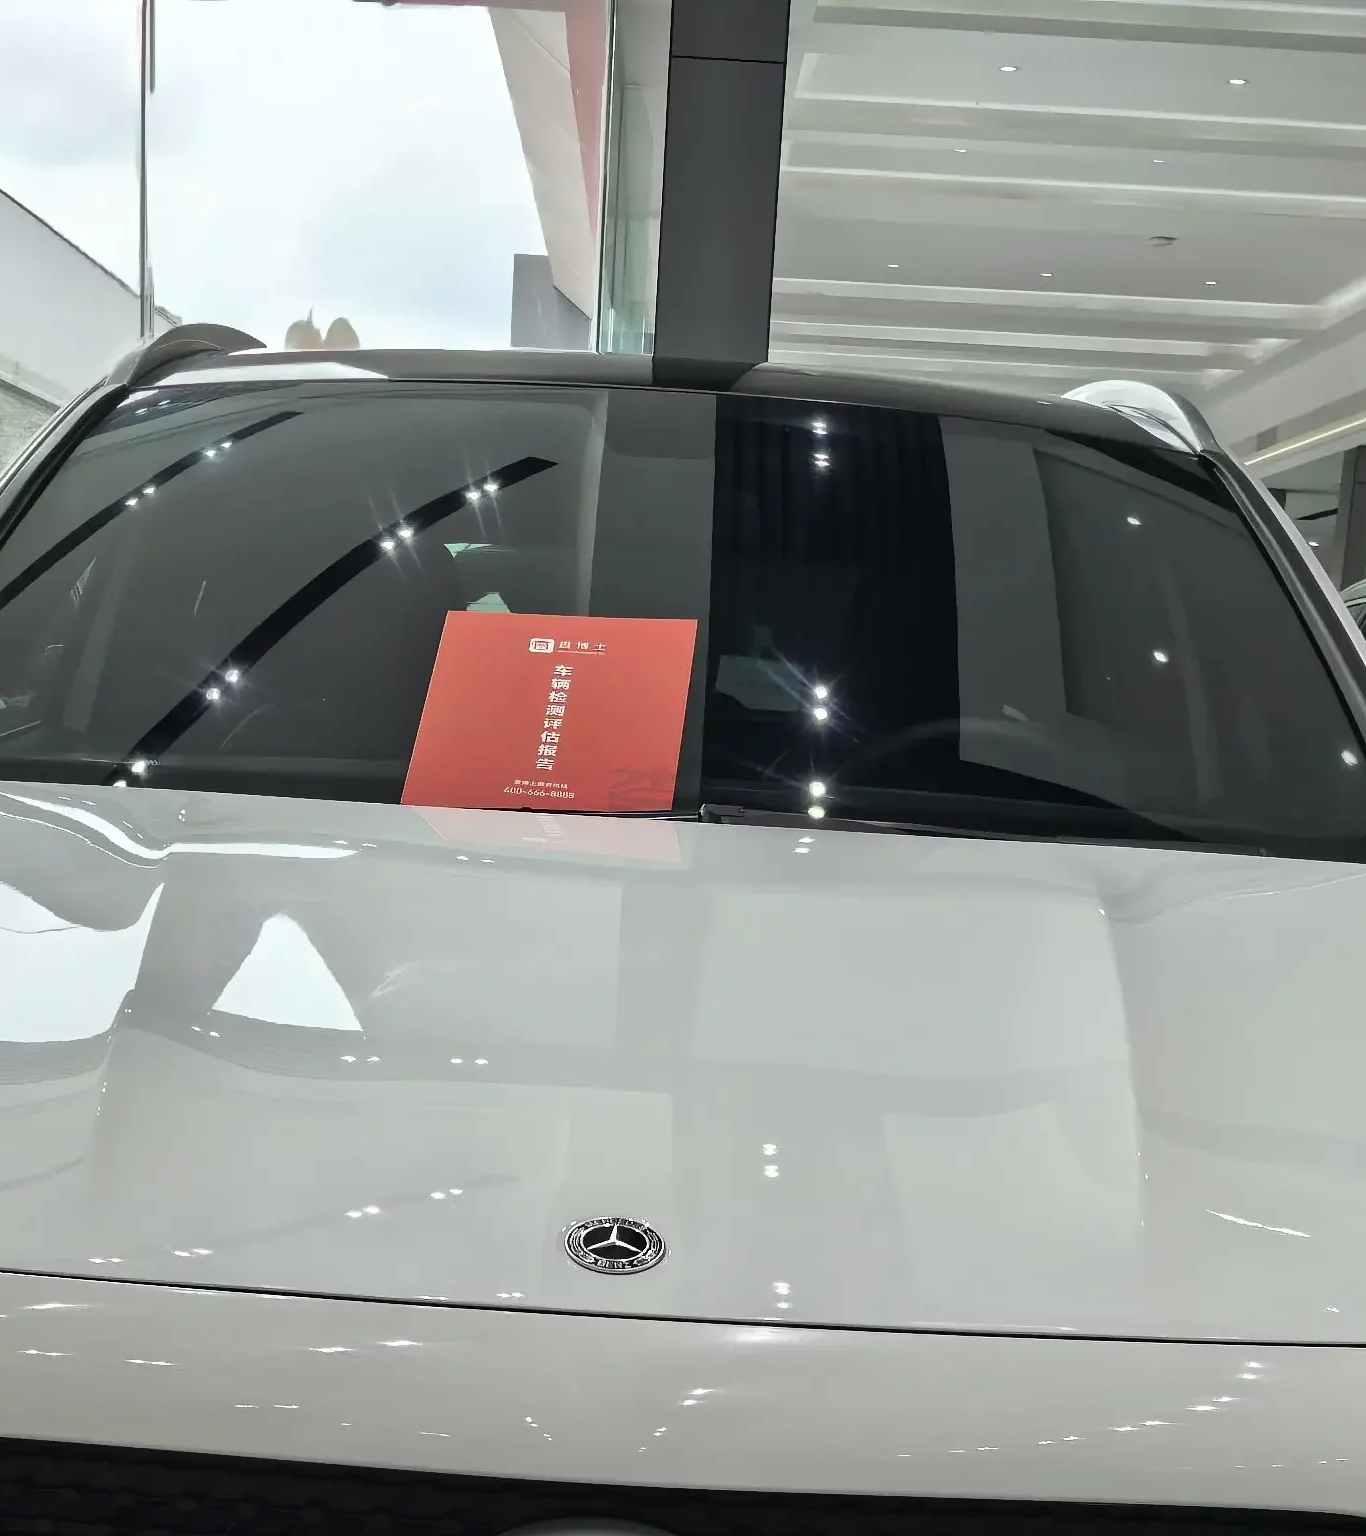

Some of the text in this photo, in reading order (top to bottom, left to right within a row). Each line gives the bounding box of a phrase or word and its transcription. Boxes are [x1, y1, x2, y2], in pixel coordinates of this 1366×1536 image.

[536, 664, 573, 771] 车辆检测评估报告
